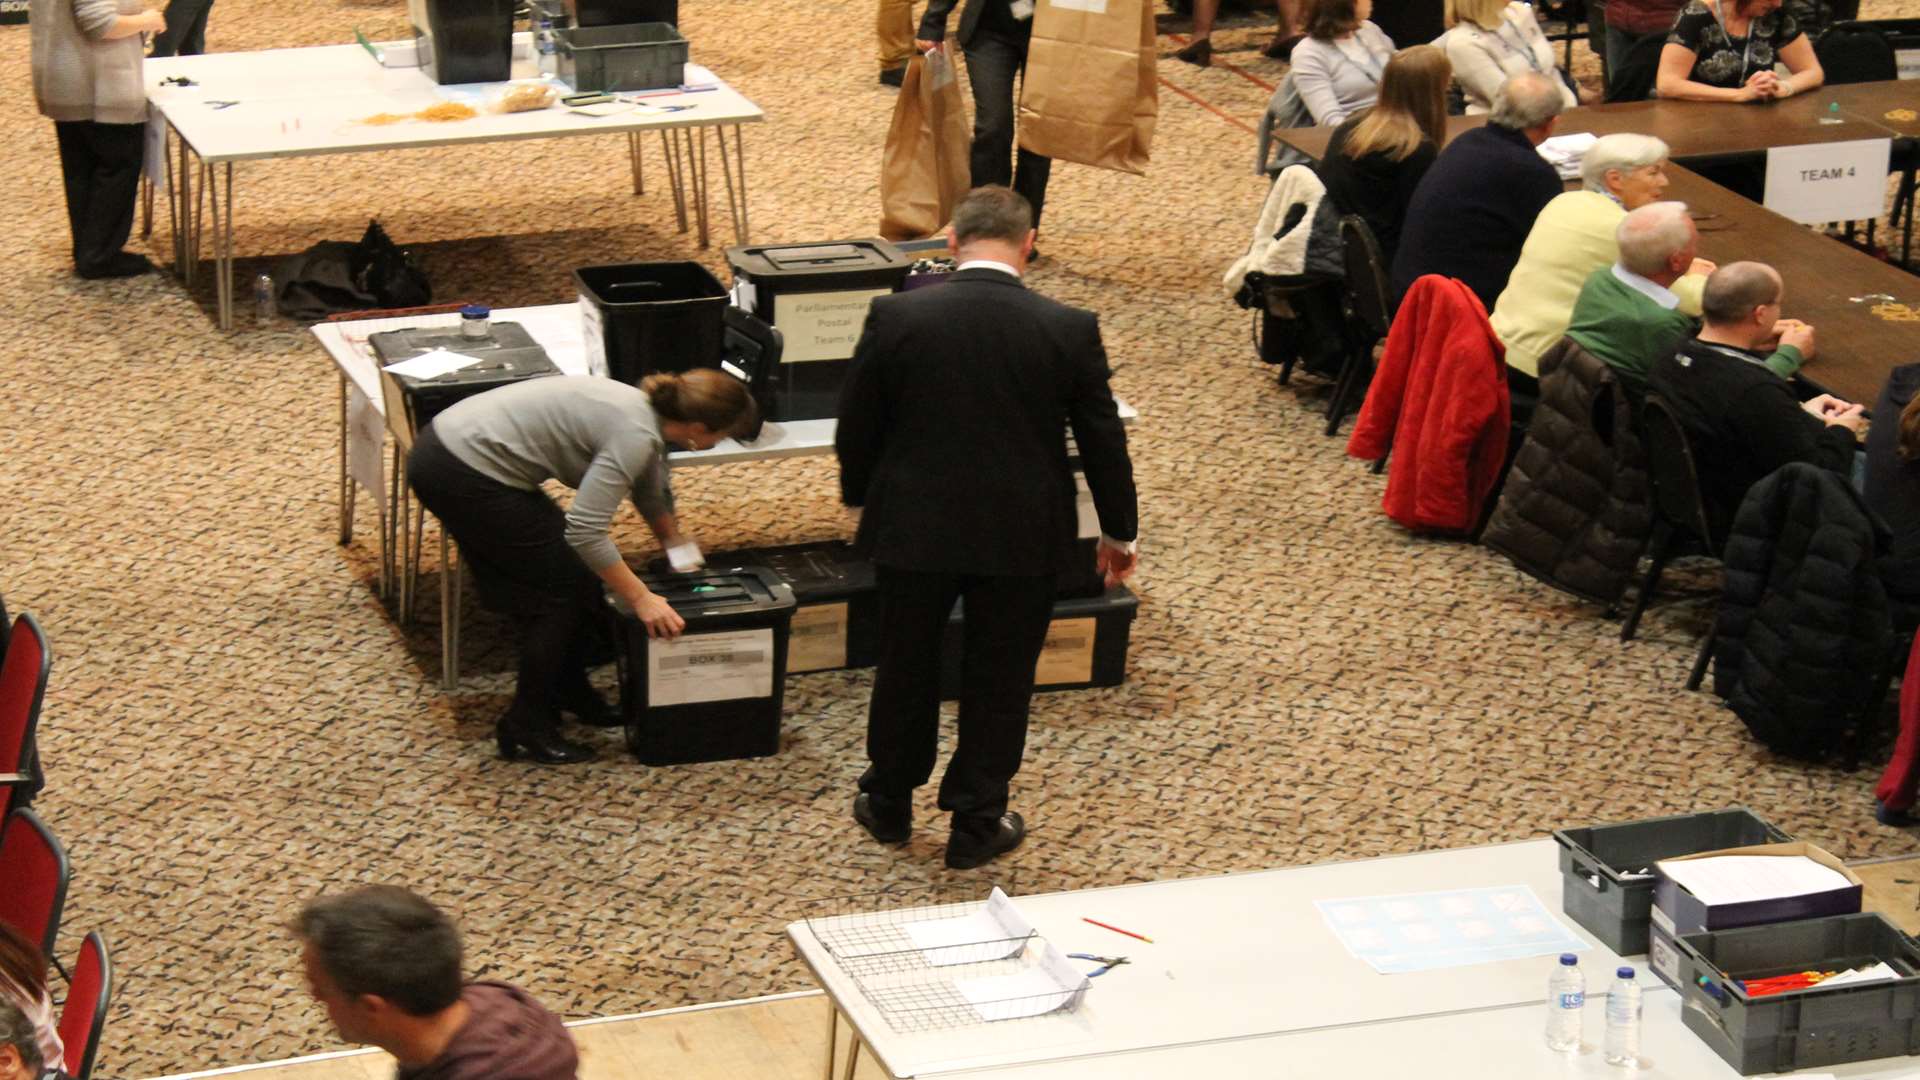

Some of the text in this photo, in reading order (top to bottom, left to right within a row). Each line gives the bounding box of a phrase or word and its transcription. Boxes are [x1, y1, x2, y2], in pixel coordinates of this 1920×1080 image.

[1800, 166, 1856, 182] TEAM 4
[795, 302, 870, 313] Parliamentar
[817, 317, 851, 328] Postal
[814, 335, 845, 345] Team
[688, 654, 716, 665] BOX
